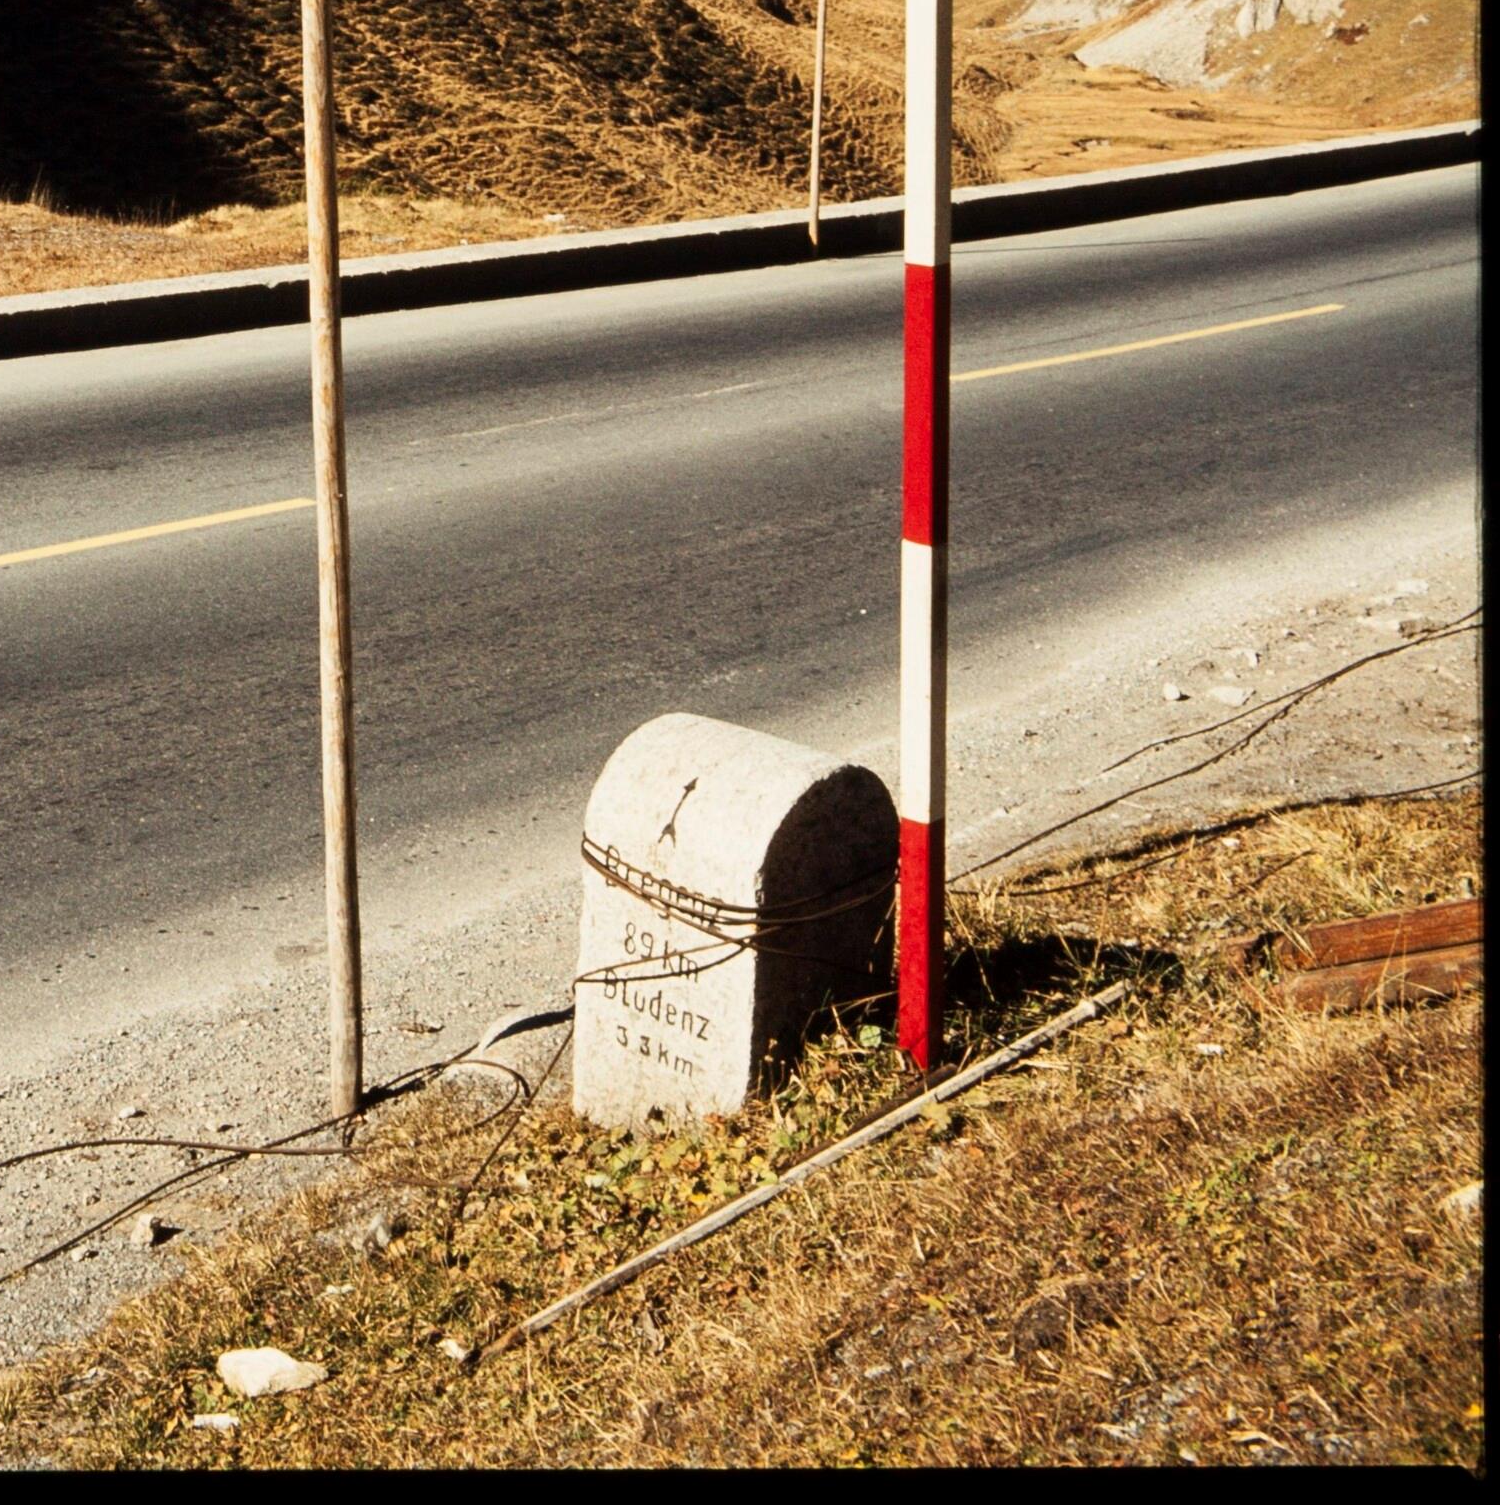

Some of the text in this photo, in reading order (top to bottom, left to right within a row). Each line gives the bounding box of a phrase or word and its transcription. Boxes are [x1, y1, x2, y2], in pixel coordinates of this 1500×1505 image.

[624, 922, 699, 983] 89 km
[604, 968, 710, 1041] Bludenz
[657, 1043, 693, 1078] km
